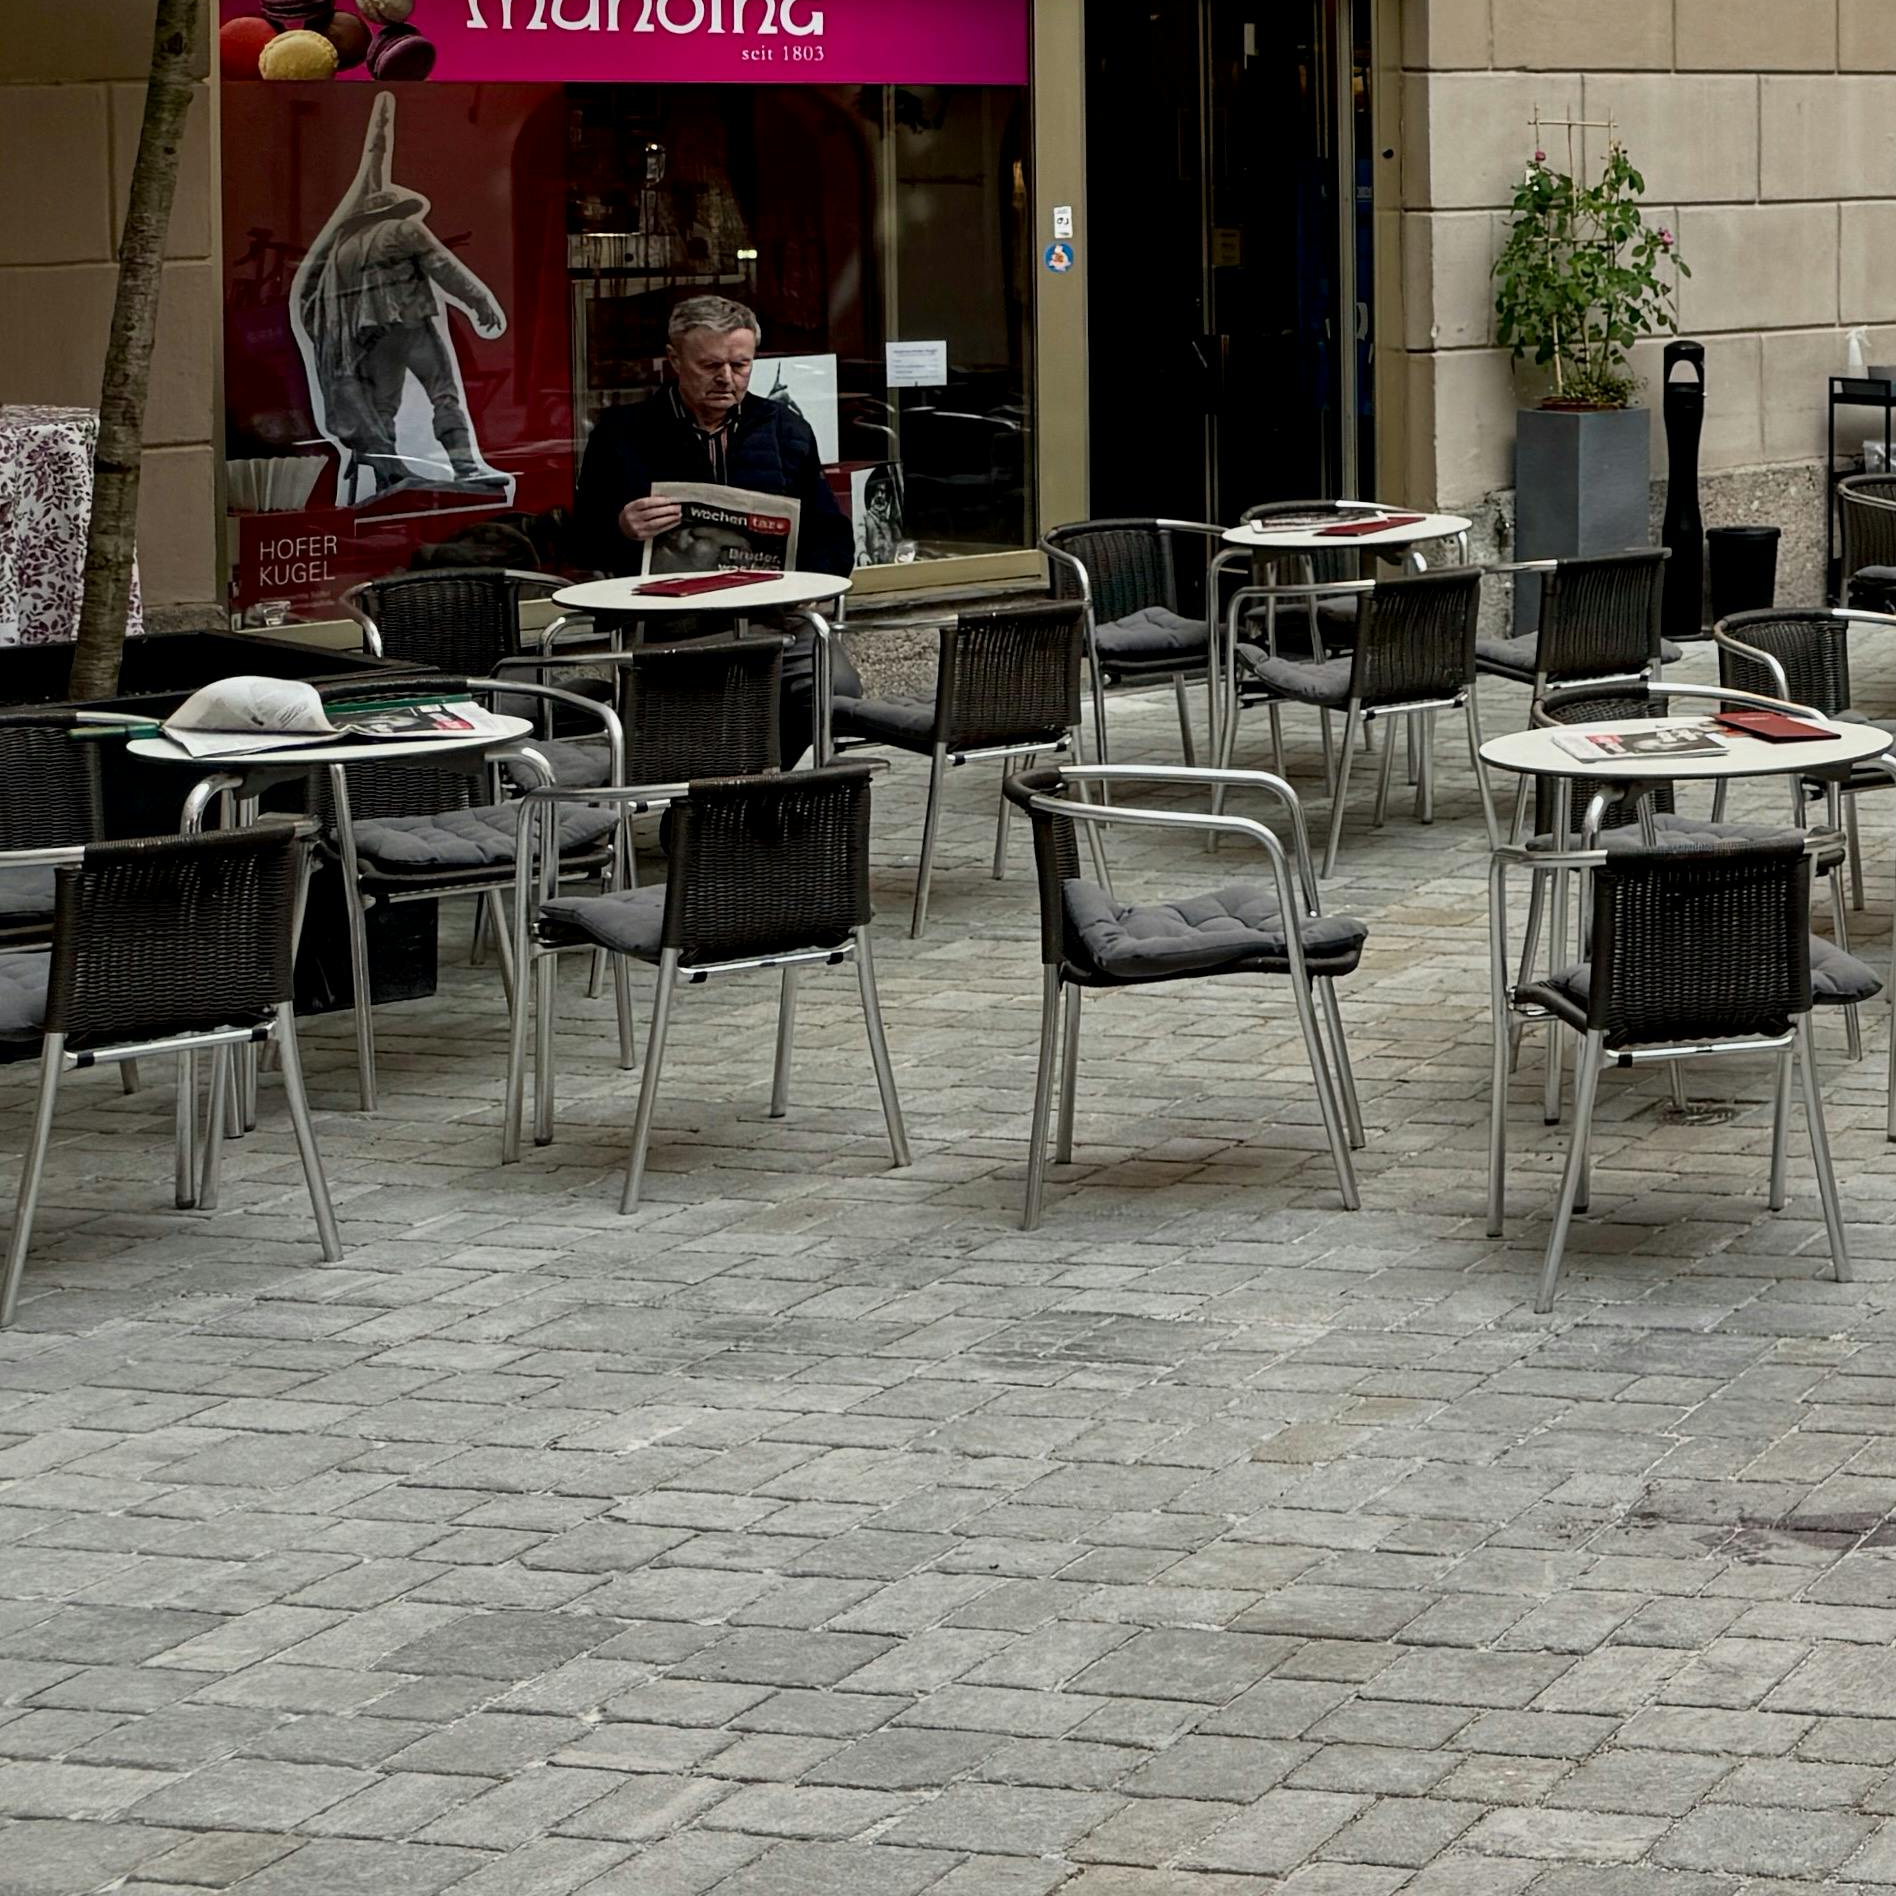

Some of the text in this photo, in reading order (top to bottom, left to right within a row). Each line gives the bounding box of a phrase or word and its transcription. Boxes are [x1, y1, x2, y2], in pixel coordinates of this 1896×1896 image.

[742, 45, 825, 62] seit 1803
[259, 535, 338, 561] HOFER
[259, 561, 337, 587] KUGEL
